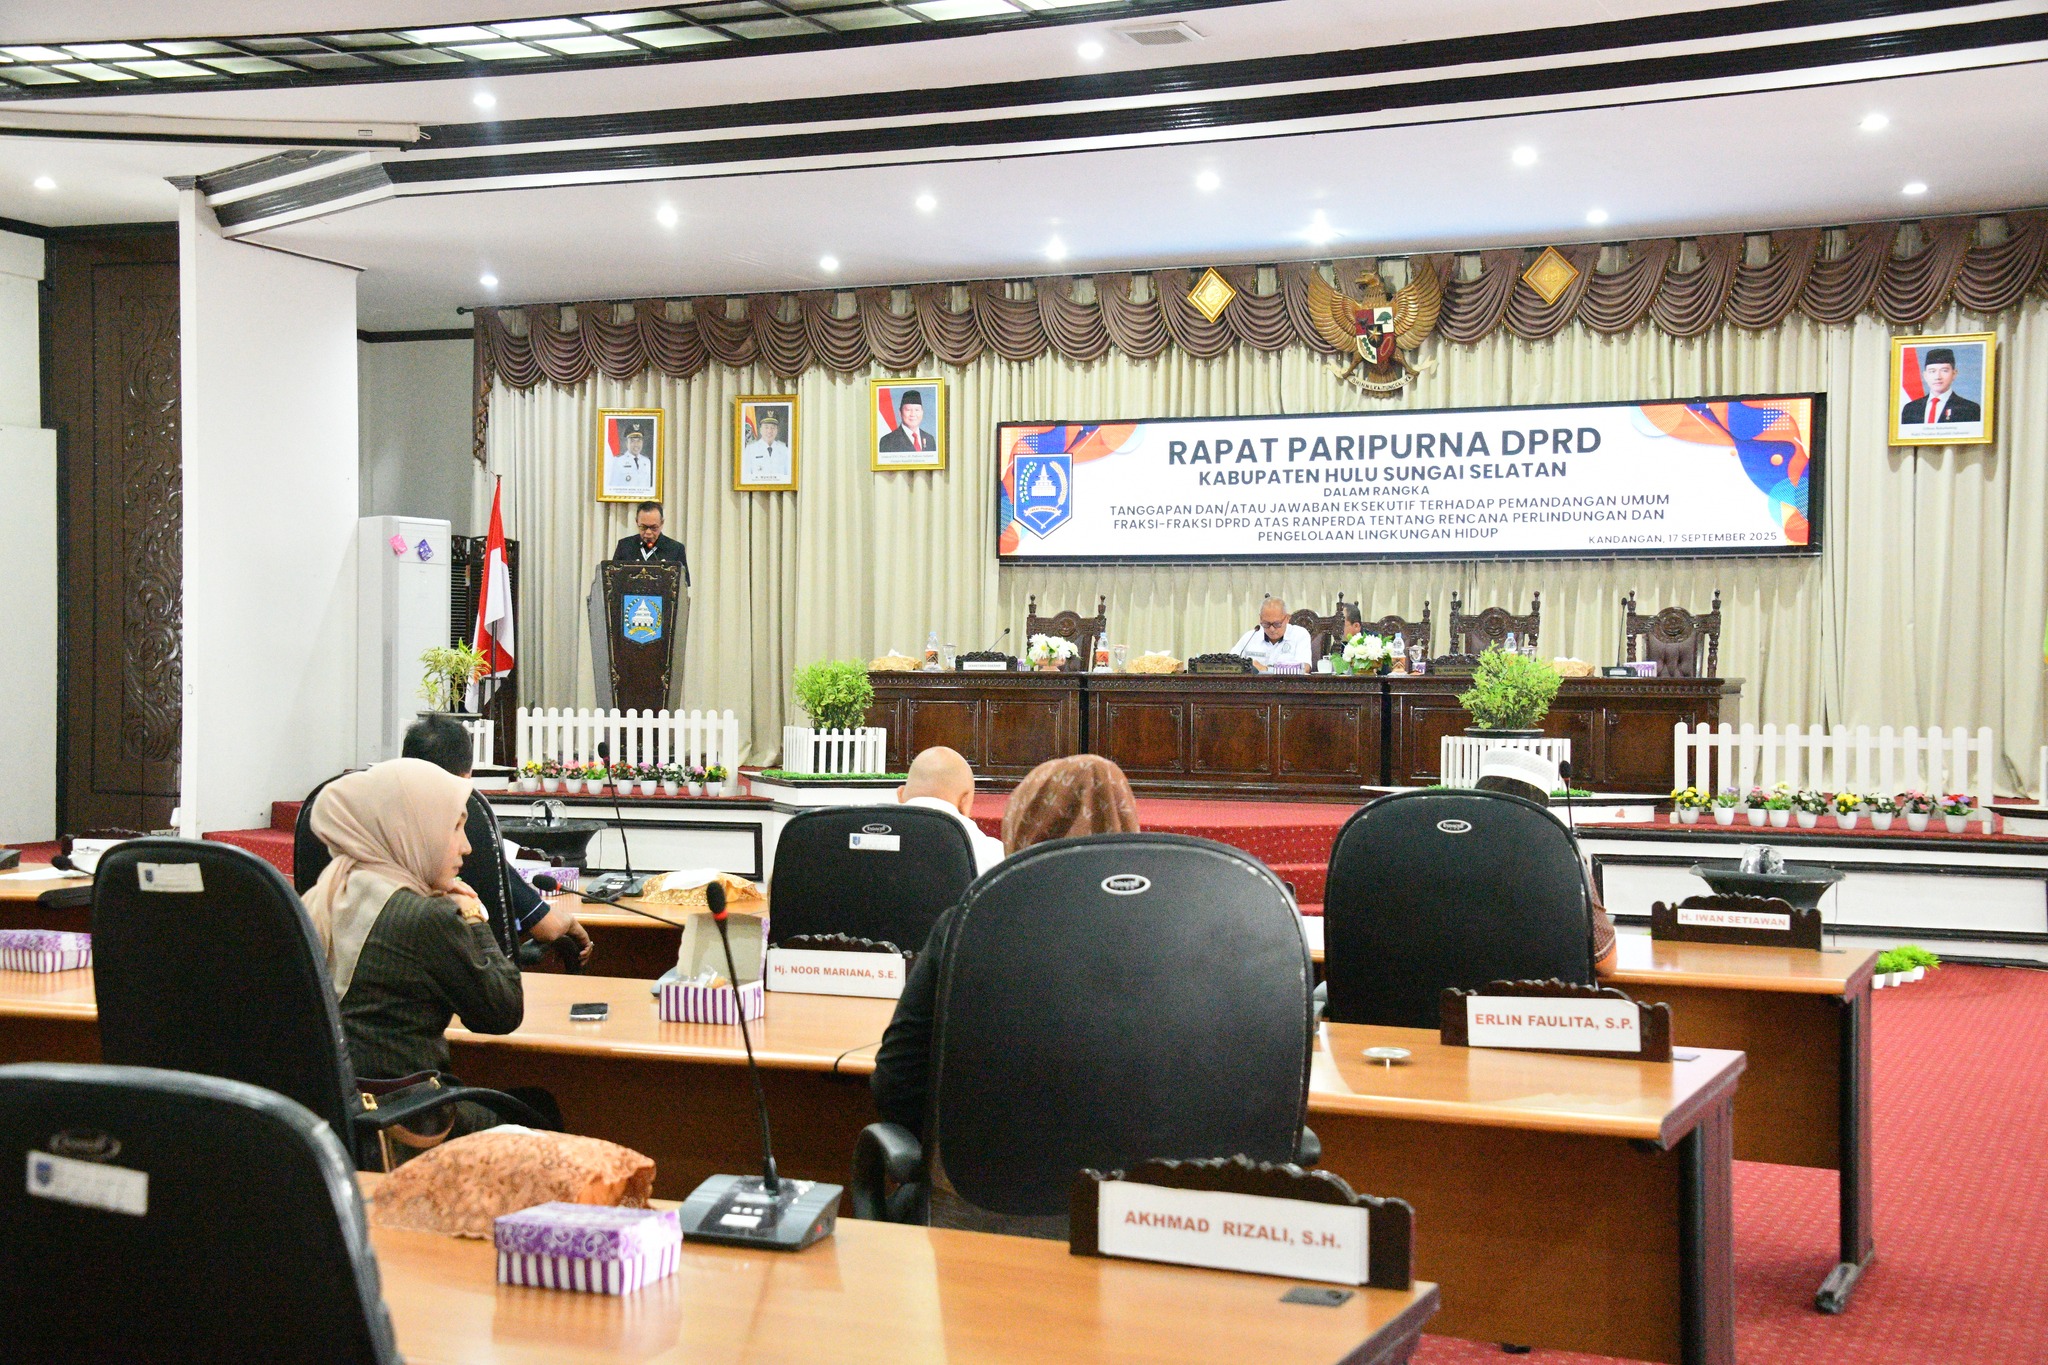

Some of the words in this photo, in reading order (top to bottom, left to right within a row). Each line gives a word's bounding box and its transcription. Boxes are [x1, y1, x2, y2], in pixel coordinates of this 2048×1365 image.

[1169, 437, 1279, 465] RAPAT
[1288, 431, 1491, 462] PARIPURNA
[1501, 427, 1602, 456] DPRD
[1199, 469, 1320, 486] KABUPATEN
[1325, 466, 1378, 483] HULU
[1383, 464, 1464, 481] SUNGAI
[1469, 461, 1567, 479] SELATAN
[1323, 486, 1370, 497] DALAM
[1373, 485, 1430, 496] RANGKA
[1110, 504, 1192, 516] TANGGAPAN
[1195, 500, 1266, 516] DAN/ATAU
[1269, 501, 1340, 513] JAWABAN
[1343, 500, 1416, 512] EKSEKUTIF
[1419, 498, 1495, 510] TERHADAP
[1498, 495, 1617, 509] PEMANDANGAN
[1621, 494, 1670, 506] UMUM
[1113, 517, 1212, 530] FRAKSI-FRAKSI
[1215, 517, 1251, 529] DPRD
[1254, 517, 1289, 528] ATAS
[1292, 515, 1366, 527] RANPERDA
[1369, 514, 1435, 526] TENTANG
[1438, 512, 1509, 525] RENCANA
[1513, 510, 1627, 523] PERLINDUNGAN
[1631, 509, 1665, 521] DAN
[1258, 530, 1354, 542] PENGELOLAAN
[1358, 528, 1451, 540] LINGKUNGAN
[1455, 527, 1499, 539] HIDUP
[1588, 534, 1665, 544] KANDANGAN,
[1668, 534, 1679, 543] 17
[1681, 533, 1746, 543] SEPTEMBER
[1749, 531, 1777, 541] 2025
[1680, 913, 1692, 922] H.
[1696, 914, 1724, 923] IWAN
[1728, 915, 1786, 926] SETIAWAN
[774, 965, 788, 975] Hj.
[791, 965, 820, 975] NOOR
[823, 967, 875, 979] MARIANA,
[878, 969, 897, 979] S.E.
[1475, 1013, 1522, 1026] ERLIN
[1528, 1015, 1600, 1030] FAULITA,
[1605, 1017, 1633, 1030] S.P.
[1124, 1210, 1210, 1233] AKHMAD
[1223, 1220, 1295, 1246] RIZALI,
[1302, 1230, 1341, 1249] S.H.
